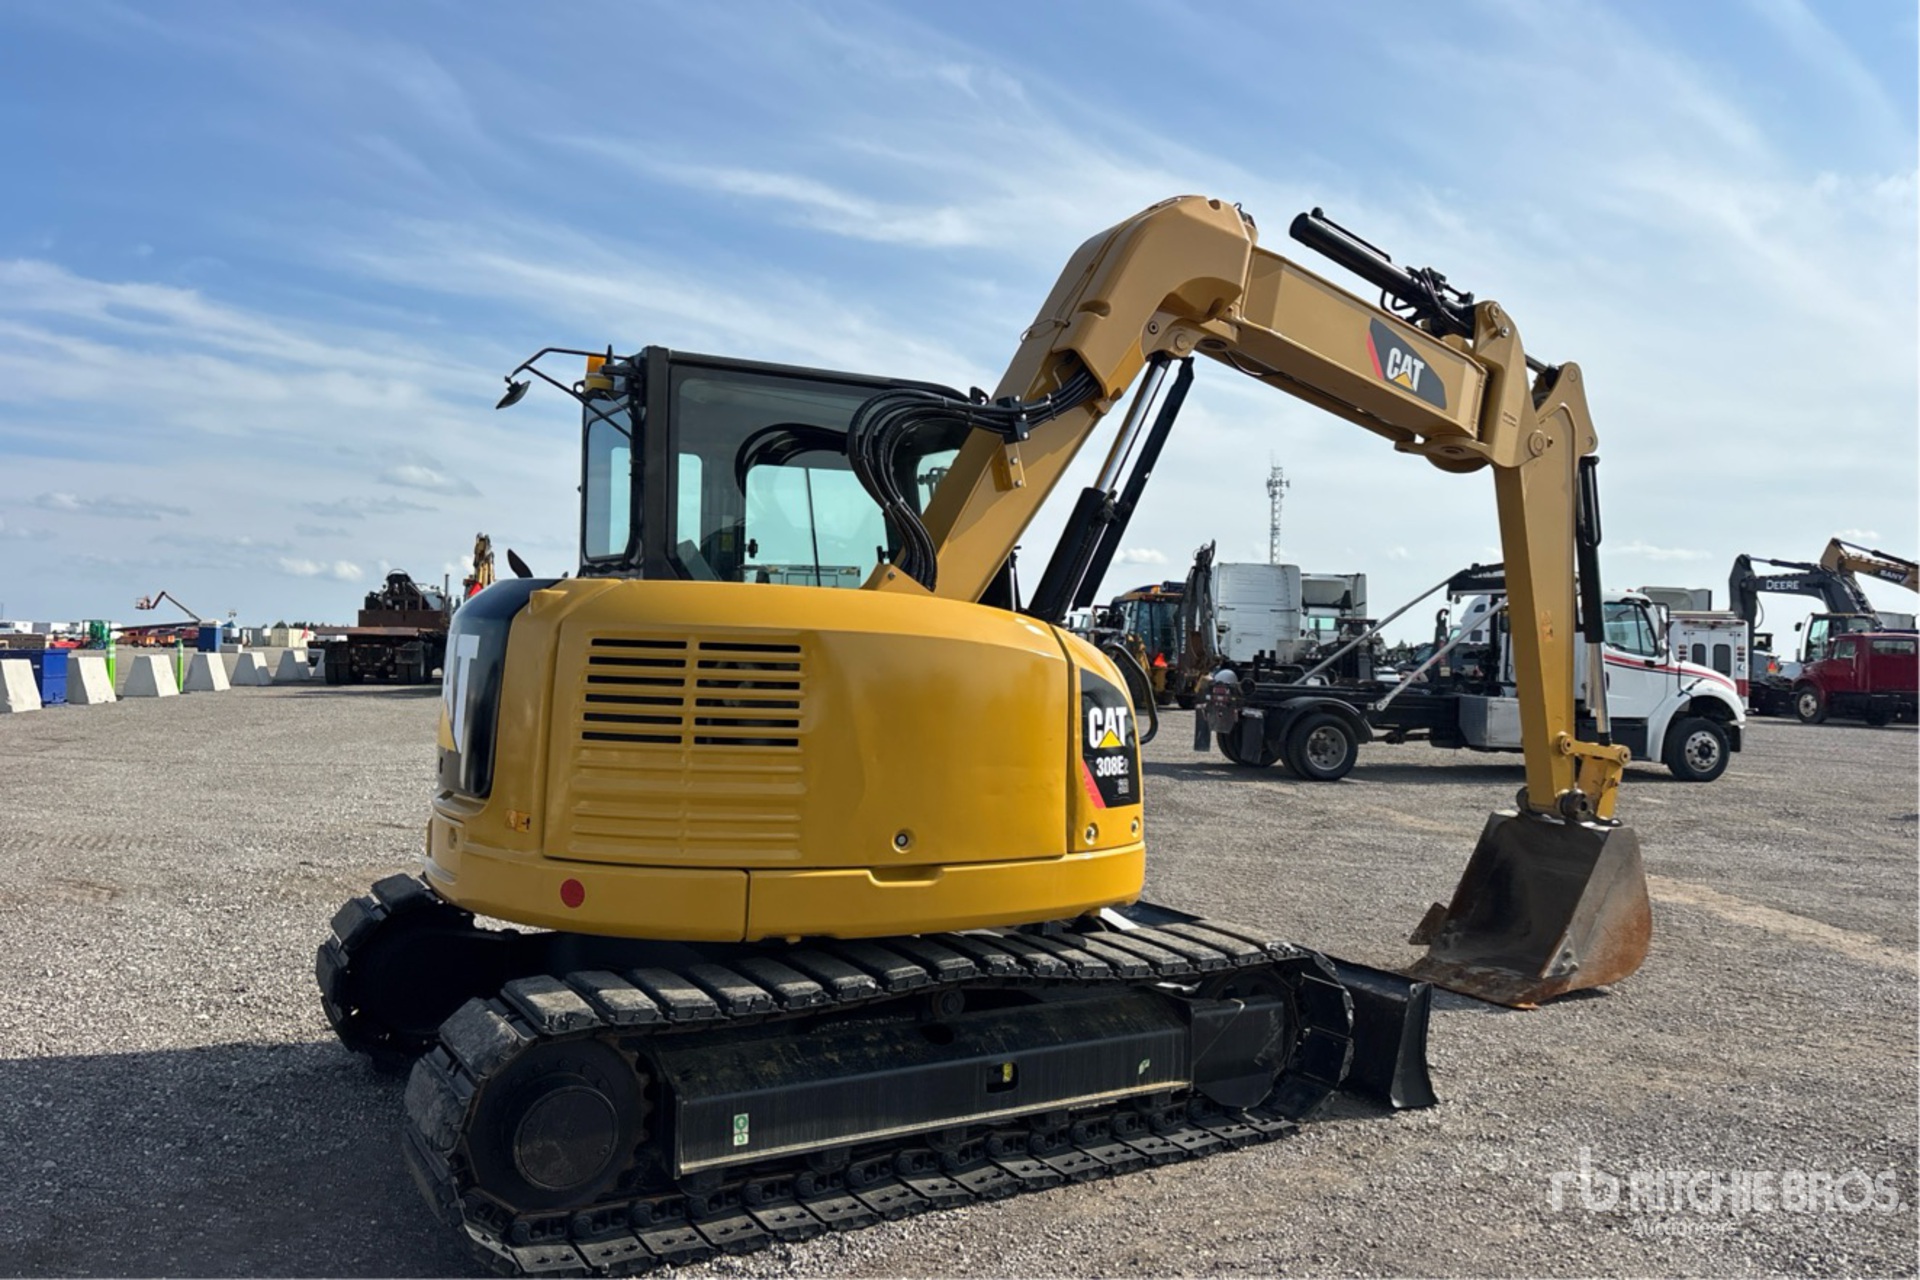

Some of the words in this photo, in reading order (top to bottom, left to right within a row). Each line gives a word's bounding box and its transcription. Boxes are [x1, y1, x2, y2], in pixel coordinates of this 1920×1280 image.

[1387, 347, 1425, 392] CAT
[1765, 579, 1800, 590] DEERE
[1088, 706, 1127, 749] CAT
